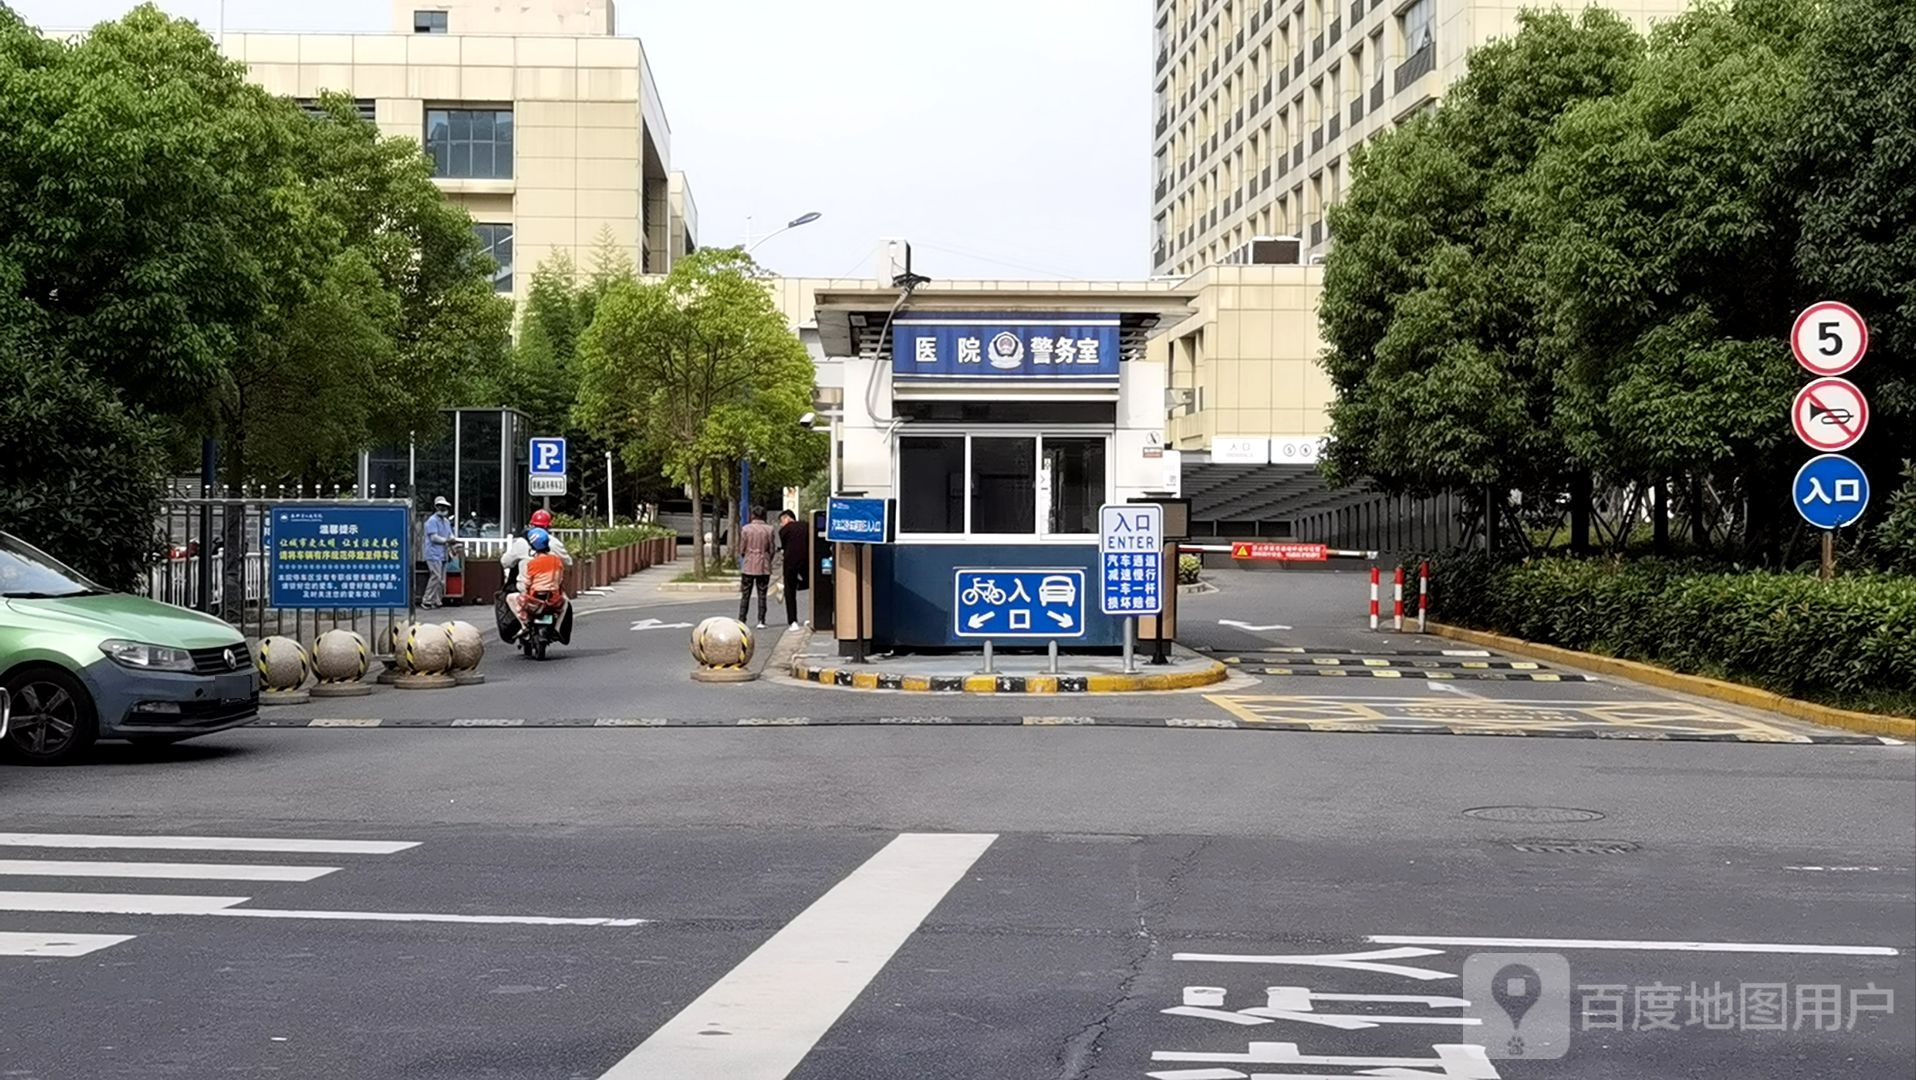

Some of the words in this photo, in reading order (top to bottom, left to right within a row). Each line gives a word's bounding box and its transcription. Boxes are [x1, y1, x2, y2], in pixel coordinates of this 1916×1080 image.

[1818, 322, 1843, 356] 5
[915, 337, 981, 363] 医院
[1030, 336, 1099, 364] 警务室
[537, 443, 559, 469] P
[1802, 477, 1859, 504] 入口
[1114, 512, 1150, 532] 入口
[319, 524, 358, 535] 温馨提示
[1108, 536, 1154, 549] ENTER
[1107, 554, 1156, 567] 汽车通道
[1107, 568, 1156, 581] 减速慢行
[1107, 582, 1156, 595] 一车一杆
[1107, 596, 1157, 609] 损坏赔偿
